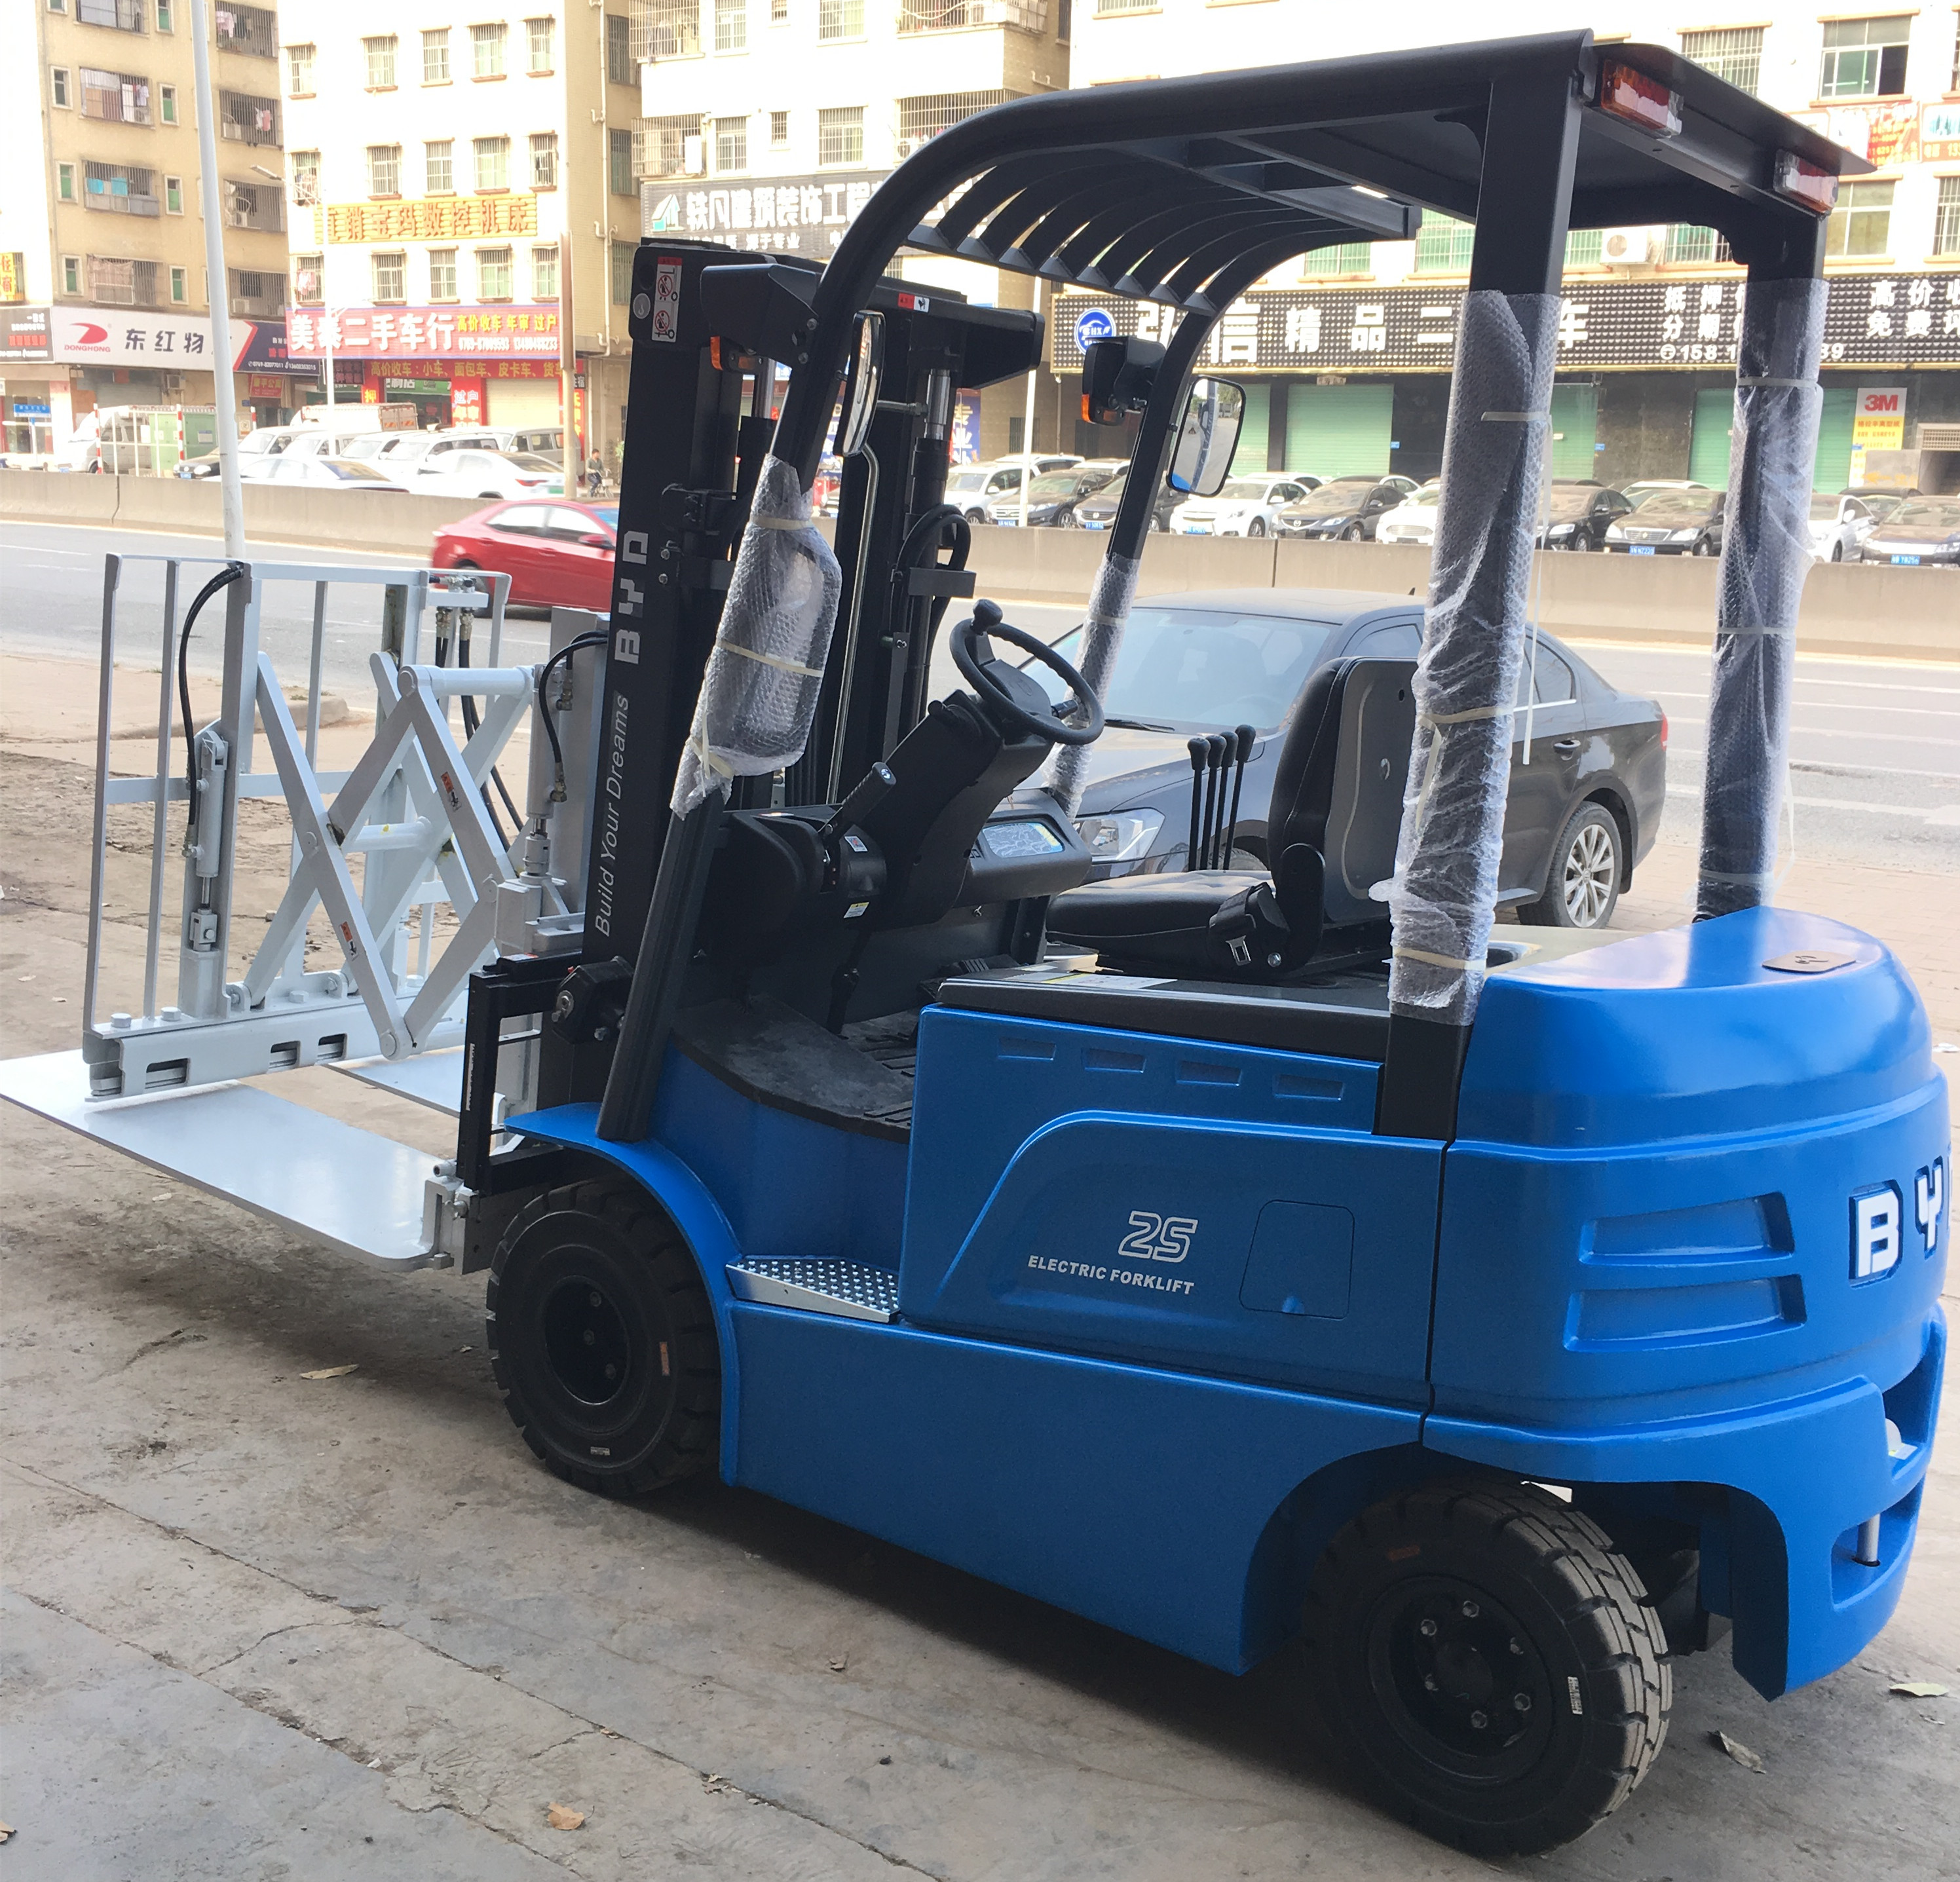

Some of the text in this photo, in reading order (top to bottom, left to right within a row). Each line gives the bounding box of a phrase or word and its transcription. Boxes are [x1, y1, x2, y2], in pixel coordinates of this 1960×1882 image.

[687, 180, 884, 231] 轶凡建筑装饰工程
[457, 313, 557, 333] 高价收车 年审 过户
[64, 344, 111, 352] DONGHONG
[124, 328, 233, 355] 东红物
[453, 389, 479, 404] 过户
[1864, 394, 1898, 411] 3M
[614, 531, 649, 664] BYD
[595, 694, 629, 937] Build Your Dreams
[1849, 1154, 1951, 1284] BY
[1028, 1254, 1195, 1294] ELECTRIC FORKLIFT
